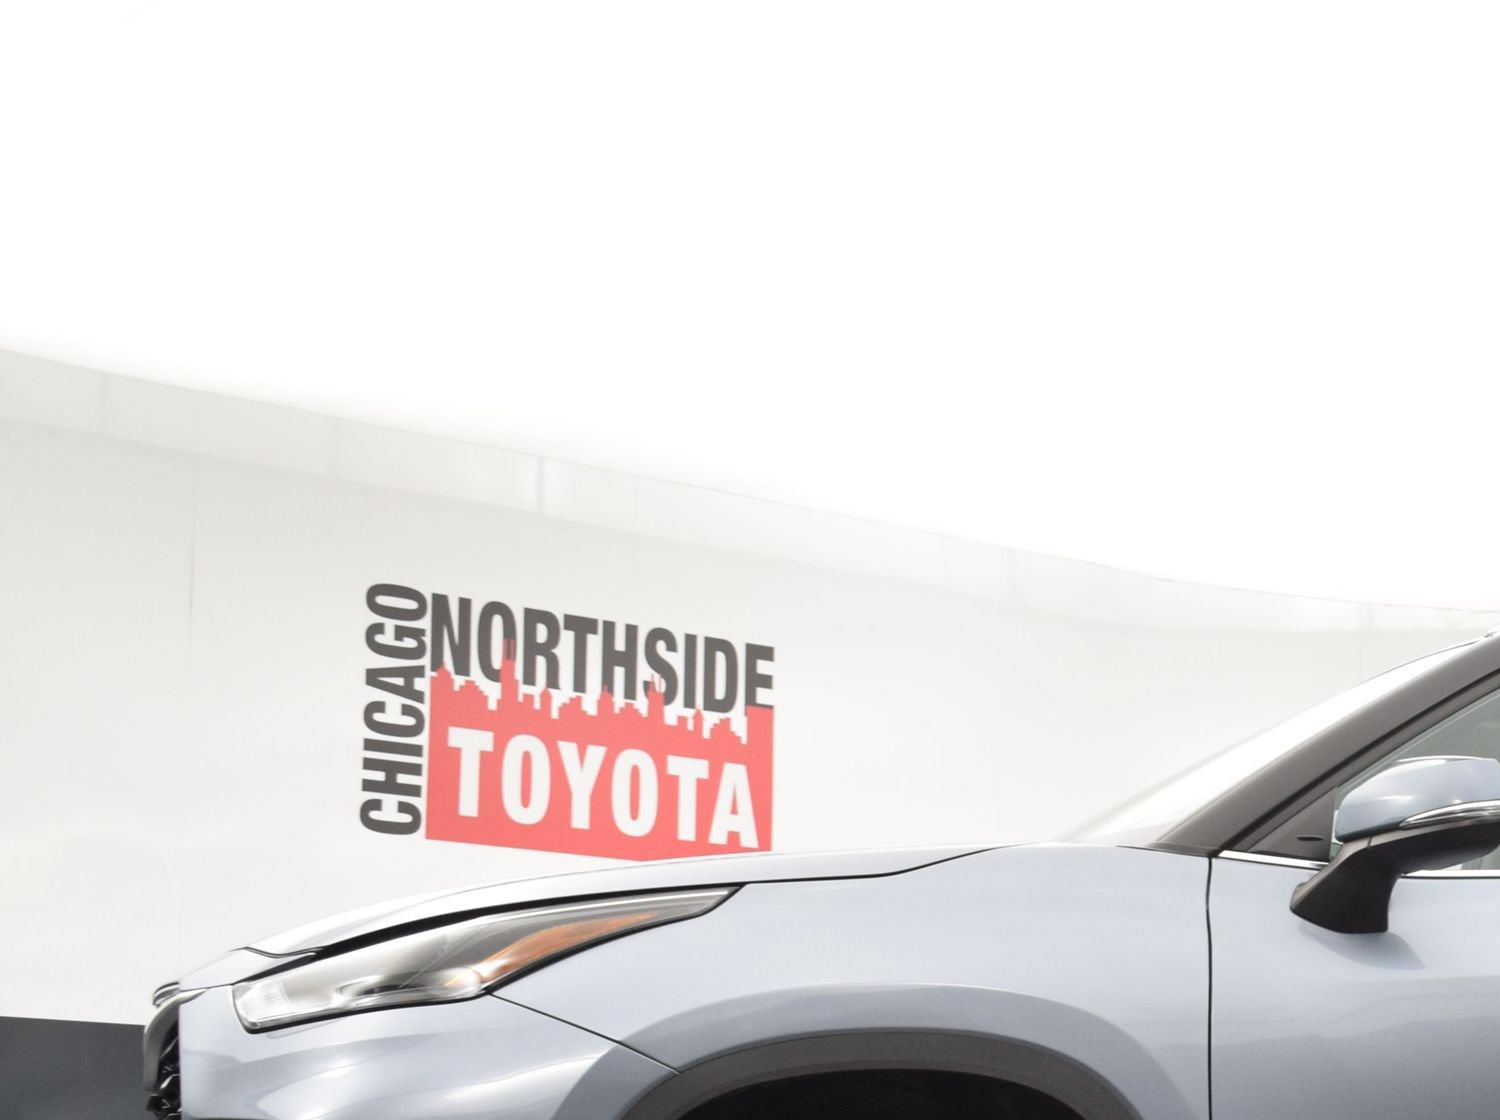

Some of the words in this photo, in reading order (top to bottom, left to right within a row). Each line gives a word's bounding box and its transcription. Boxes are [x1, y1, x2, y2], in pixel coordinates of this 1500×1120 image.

[359, 582, 428, 836] CHICAGO
[430, 592, 775, 714] NORTHSIDE
[447, 726, 760, 850] TOYOTA
